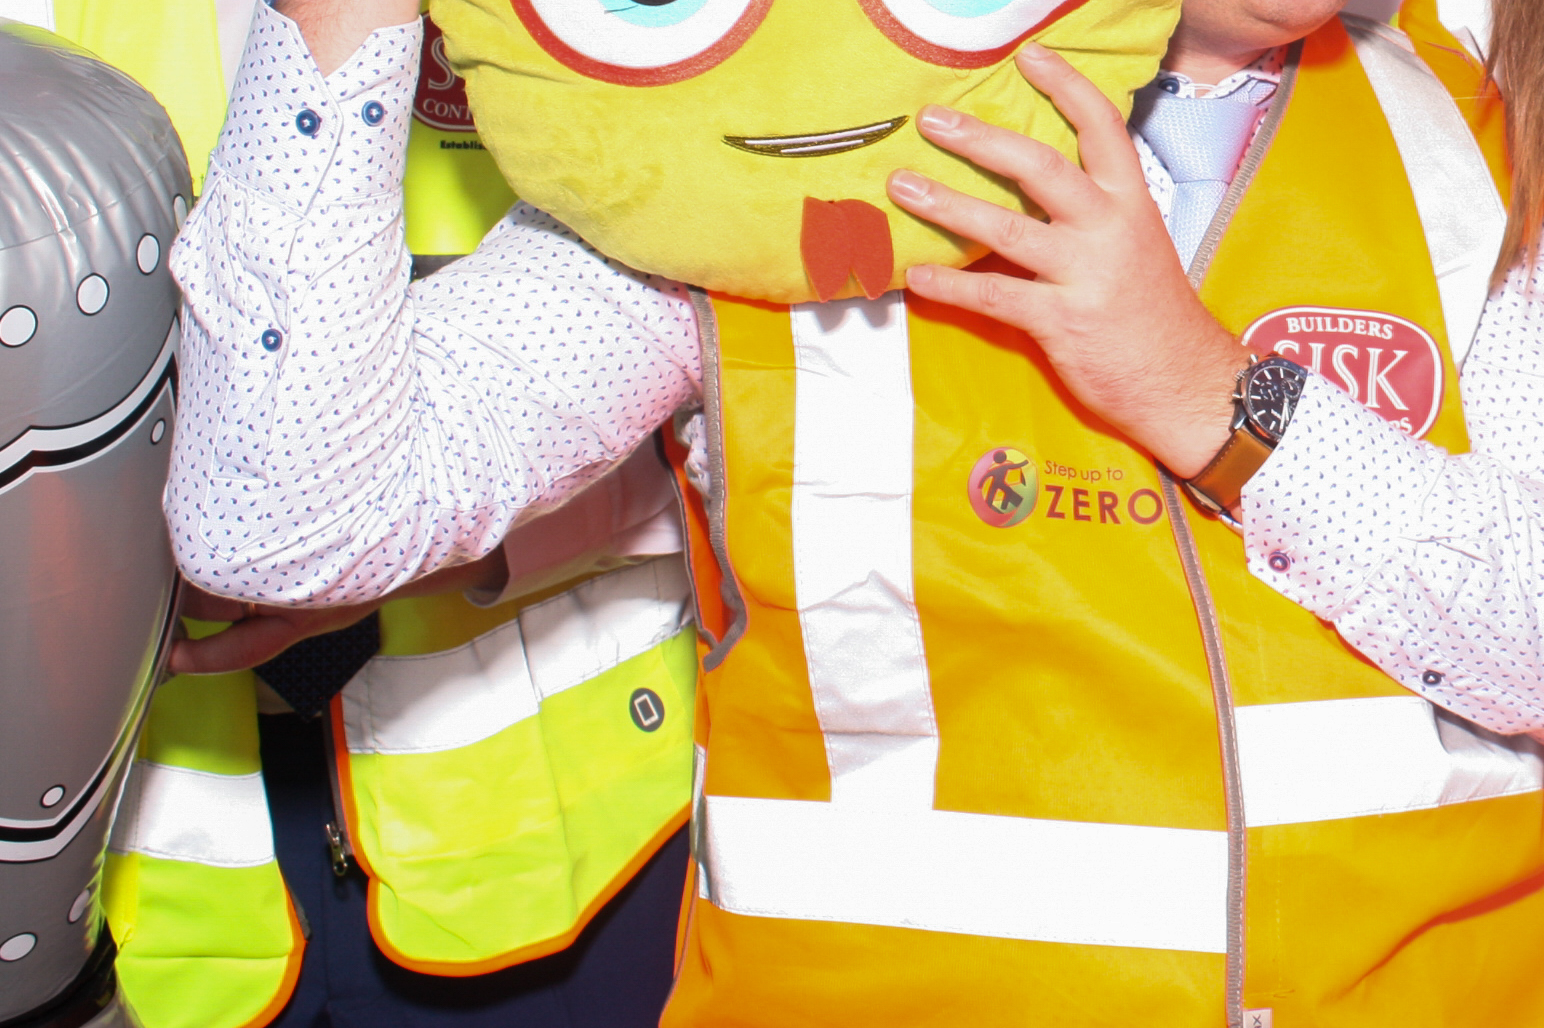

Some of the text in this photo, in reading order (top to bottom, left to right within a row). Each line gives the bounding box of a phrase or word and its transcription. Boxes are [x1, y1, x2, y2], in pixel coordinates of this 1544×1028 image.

[1286, 316, 1393, 340] BUILDERS
[1044, 460, 1123, 484] Step up to
[1045, 484, 1163, 525] ZERO
